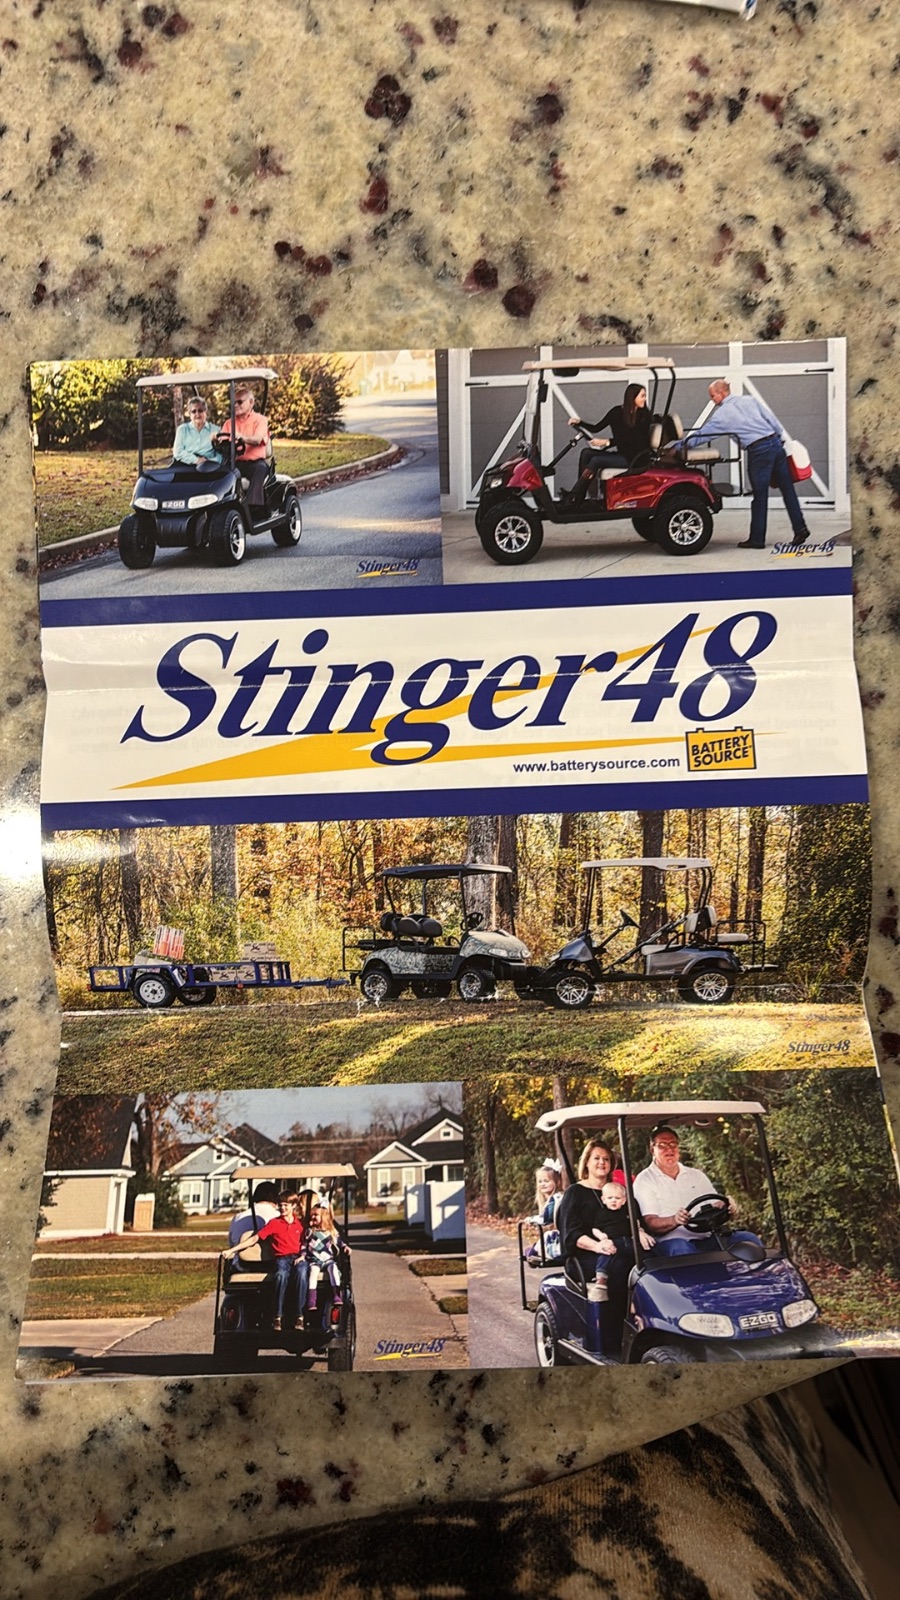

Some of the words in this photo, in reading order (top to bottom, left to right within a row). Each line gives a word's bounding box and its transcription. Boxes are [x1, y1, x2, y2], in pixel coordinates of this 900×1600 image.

[771, 540, 836, 557] Stinger48
[356, 558, 419, 574] Stinger48
[120, 611, 777, 765] Stinger48
[691, 734, 750, 756] BATTERY
[513, 757, 680, 773] www.batterysource.com
[693, 746, 749, 767] SOURCE
[787, 1040, 850, 1055] Stinger48
[373, 1338, 446, 1357] Stinger48
